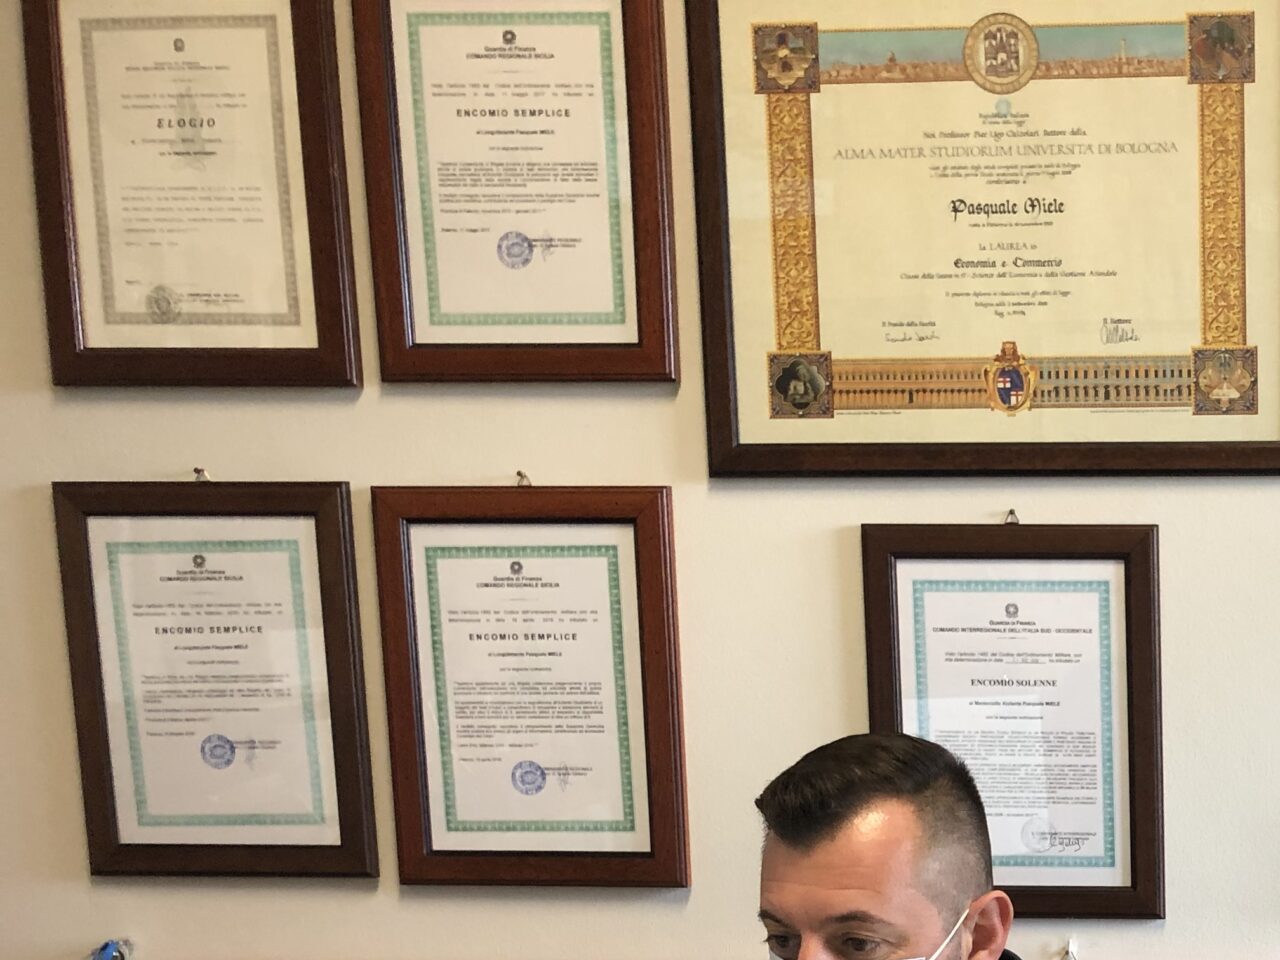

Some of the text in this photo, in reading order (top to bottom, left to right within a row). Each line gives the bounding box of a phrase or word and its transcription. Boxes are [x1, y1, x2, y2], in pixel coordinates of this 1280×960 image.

[456, 109, 571, 117] ENCOMIO SEMPLICE
[157, 117, 216, 129] ELOGIO
[833, 147, 876, 160] ALMA
[879, 147, 926, 159] MATER
[929, 146, 1012, 157] STUDIORUM
[1097, 144, 1112, 155] DI
[1115, 142, 1179, 155] BOLOGNA
[949, 197, 1065, 221] Pasquale Miele
[953, 257, 997, 268] Economia
[1012, 256, 1063, 268] Commercio
[154, 626, 263, 634] ENCOMIO SEMPLICE
[469, 633, 578, 641] ENCOMIO SEMPLICE
[971, 679, 1058, 687] ENCOMIO SOLENNE
